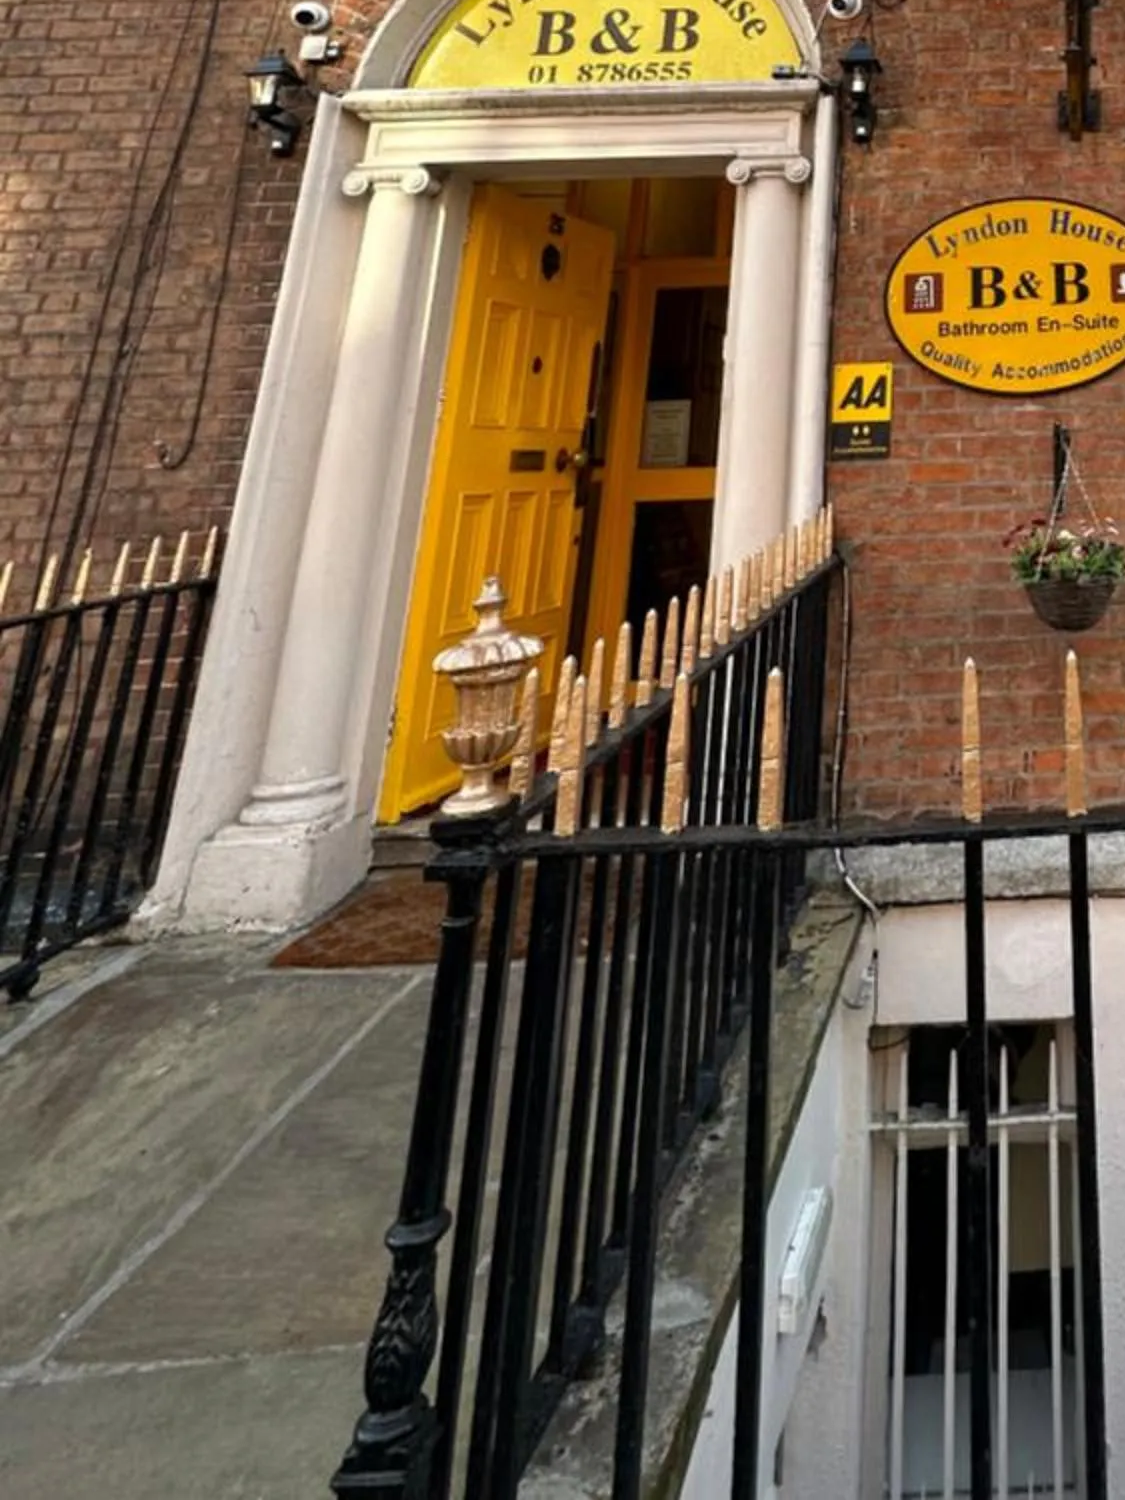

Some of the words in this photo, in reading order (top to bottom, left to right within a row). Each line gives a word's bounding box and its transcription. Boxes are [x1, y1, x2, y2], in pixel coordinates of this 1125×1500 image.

[528, 65, 558, 84] 01
[577, 61, 693, 83] 8786555
[926, 212, 1029, 259] Lyndon
[938, 318, 1029, 337] Bathroom
[1037, 313, 1120, 333] En-Suite
[920, 339, 982, 379] Quality
[839, 375, 887, 411] AA
